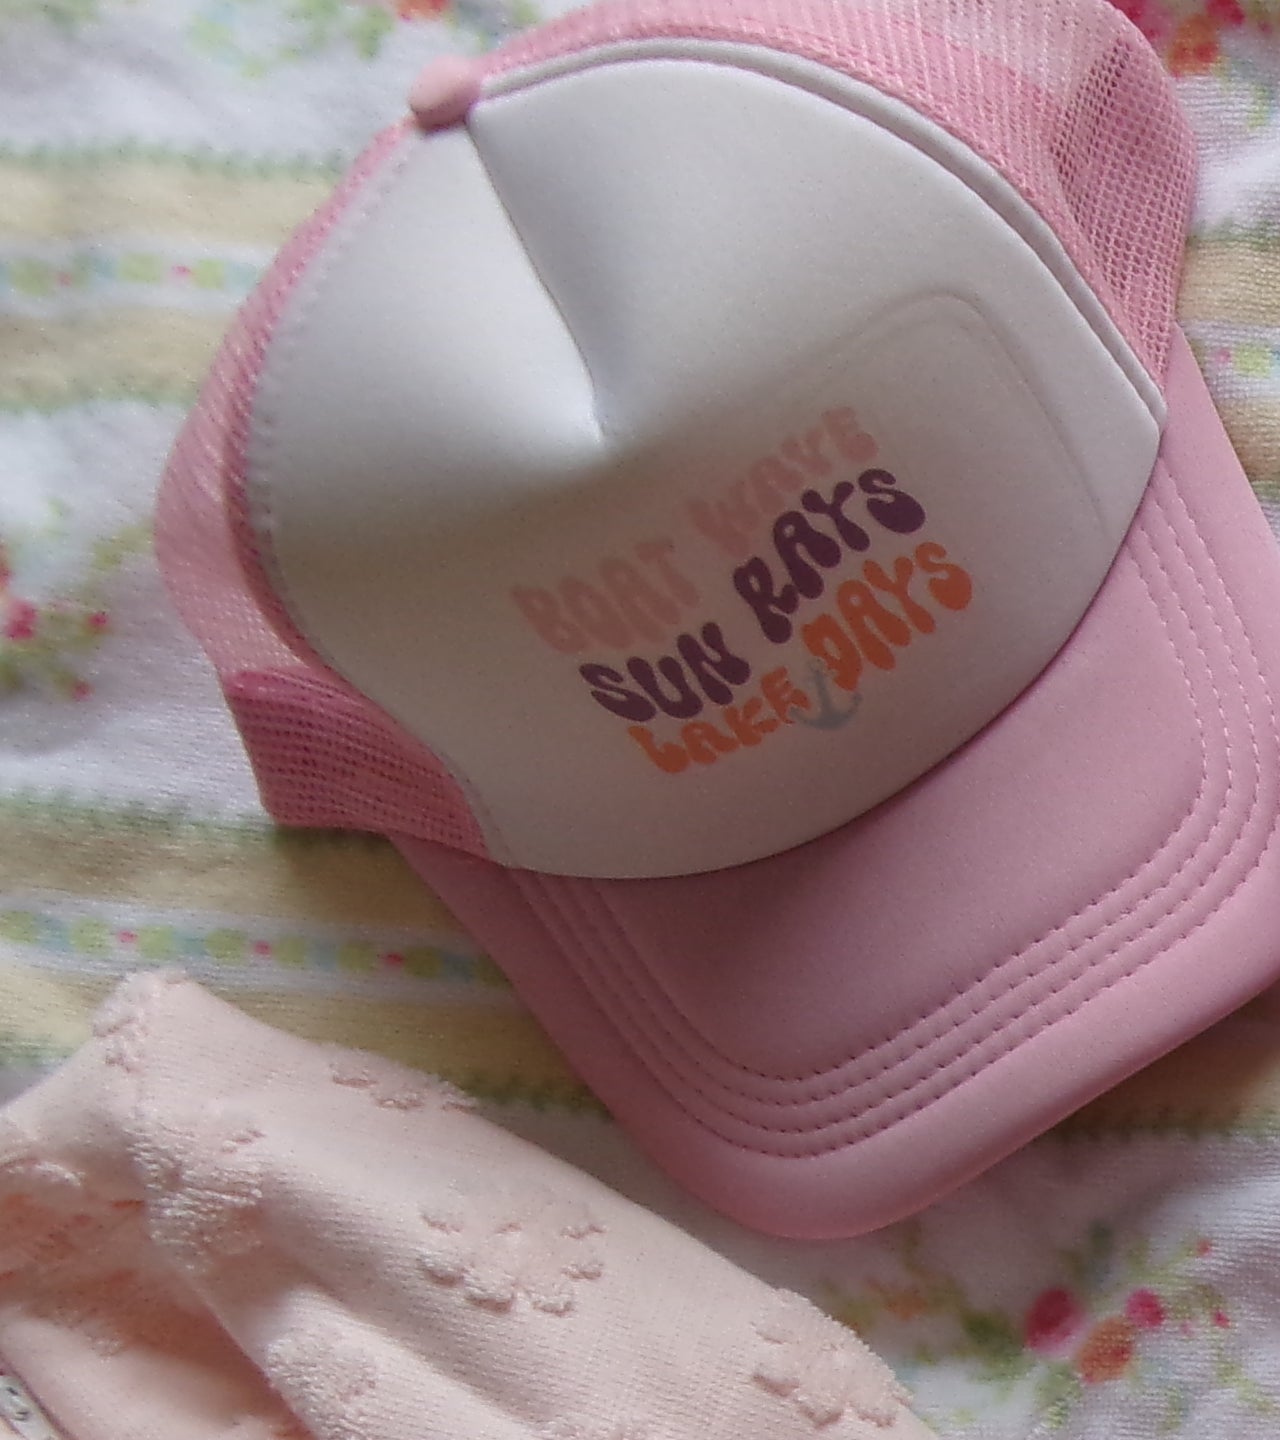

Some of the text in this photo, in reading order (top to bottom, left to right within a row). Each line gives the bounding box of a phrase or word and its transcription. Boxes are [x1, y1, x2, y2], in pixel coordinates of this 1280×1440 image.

[510, 406, 878, 654] BOAT WAVE
[578, 468, 926, 722] SUN RAYS
[627, 541, 972, 774] LAKE DAYS
